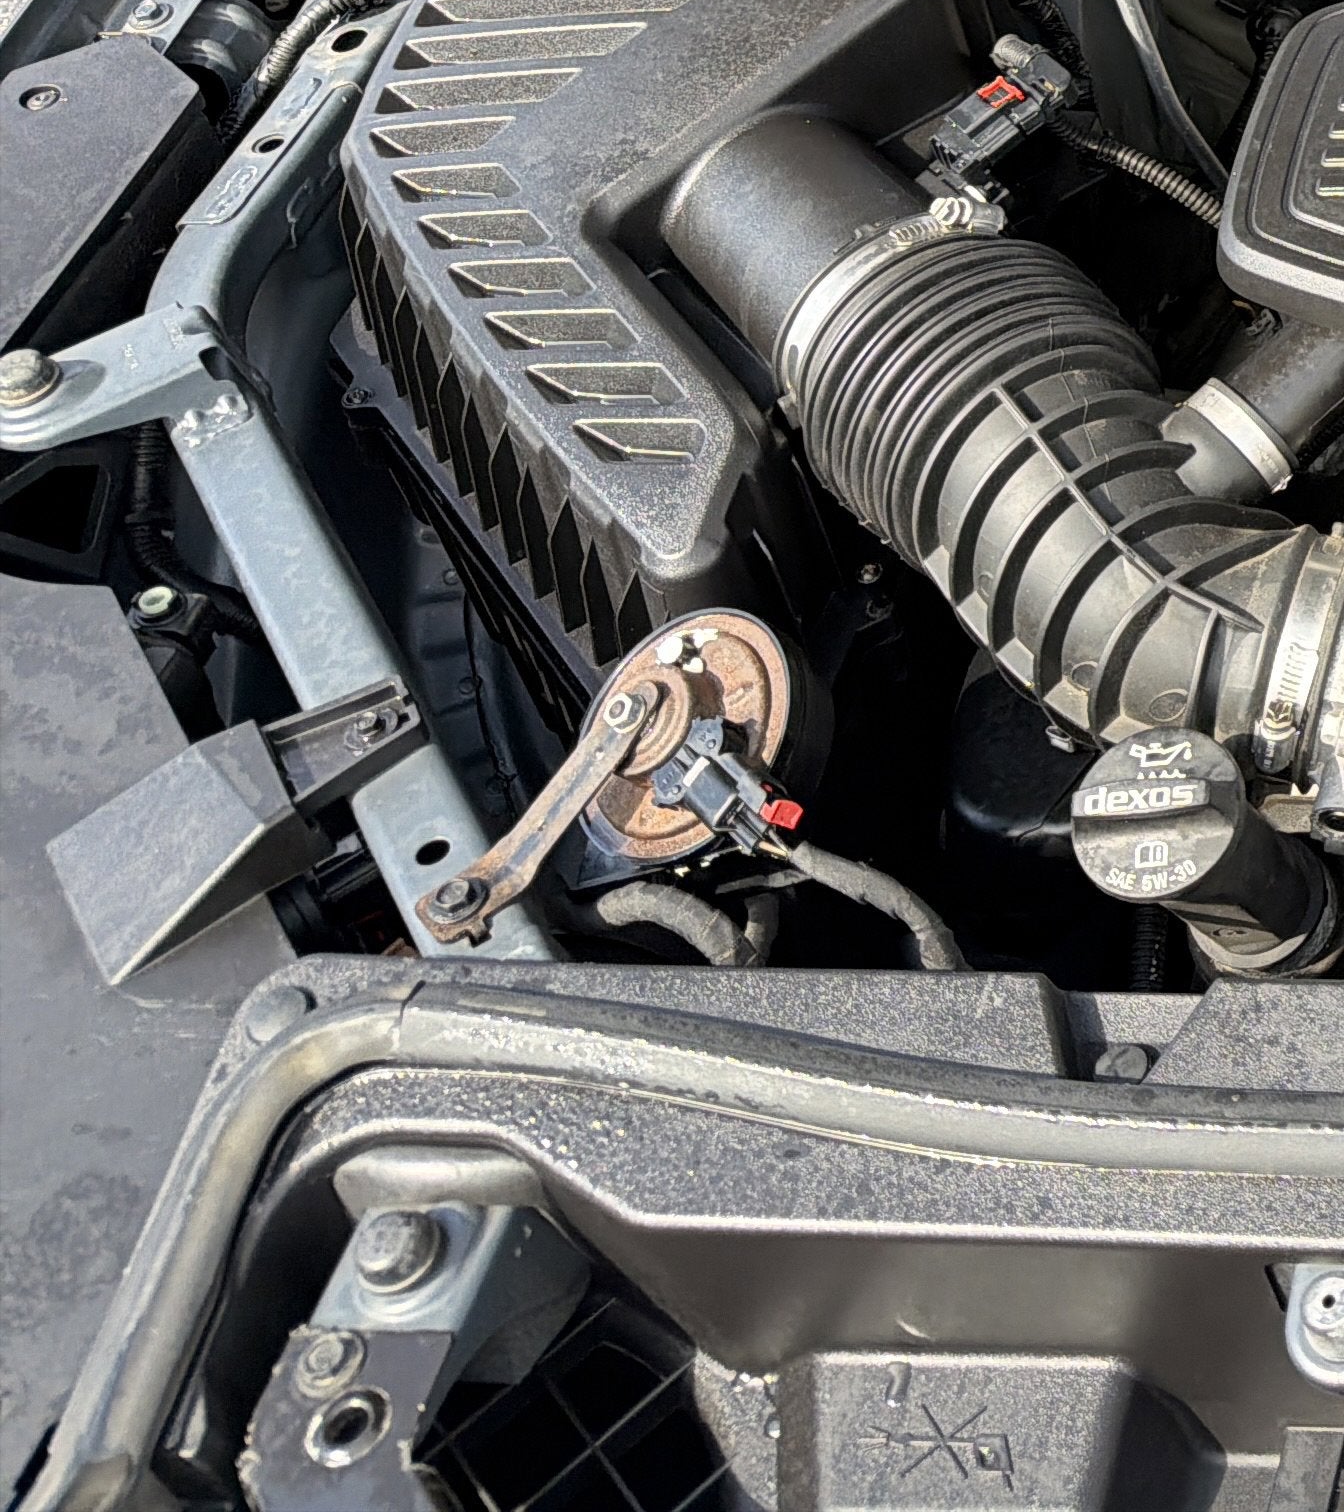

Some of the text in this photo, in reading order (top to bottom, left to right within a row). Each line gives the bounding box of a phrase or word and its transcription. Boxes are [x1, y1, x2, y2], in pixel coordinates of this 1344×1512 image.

[1083, 784, 1198, 816] dexos
[1105, 859, 1197, 892] SAE 5W-30
